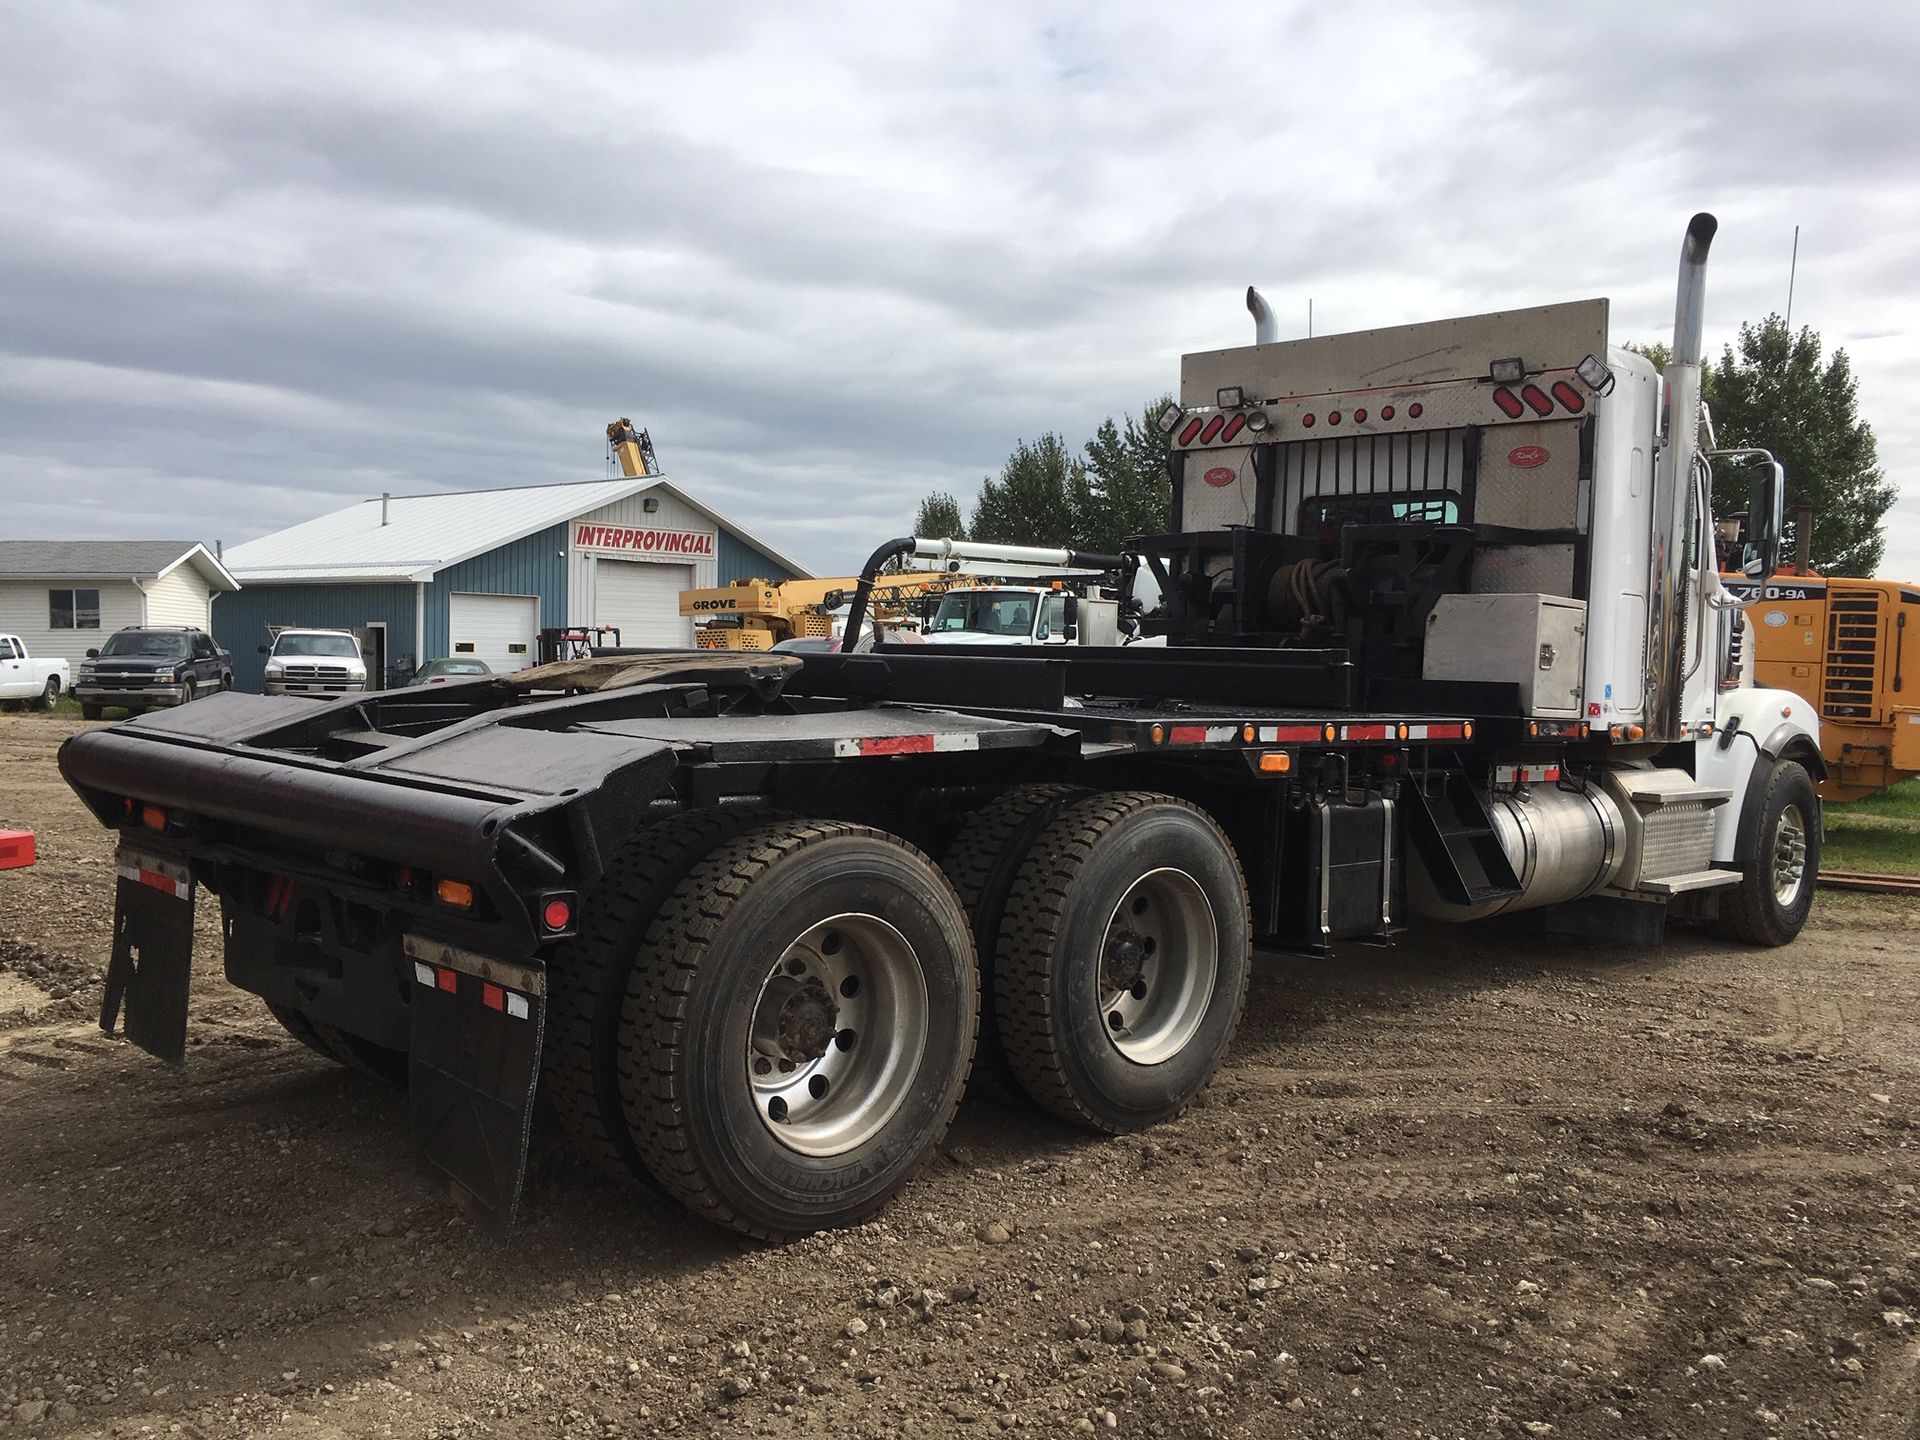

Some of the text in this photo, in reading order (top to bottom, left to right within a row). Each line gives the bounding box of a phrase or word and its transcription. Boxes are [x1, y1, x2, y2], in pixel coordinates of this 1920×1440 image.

[576, 525, 712, 554] INTERPROVINCIAL
[1726, 586, 1807, 600] 760-9A
[692, 599, 737, 610] GROVE
